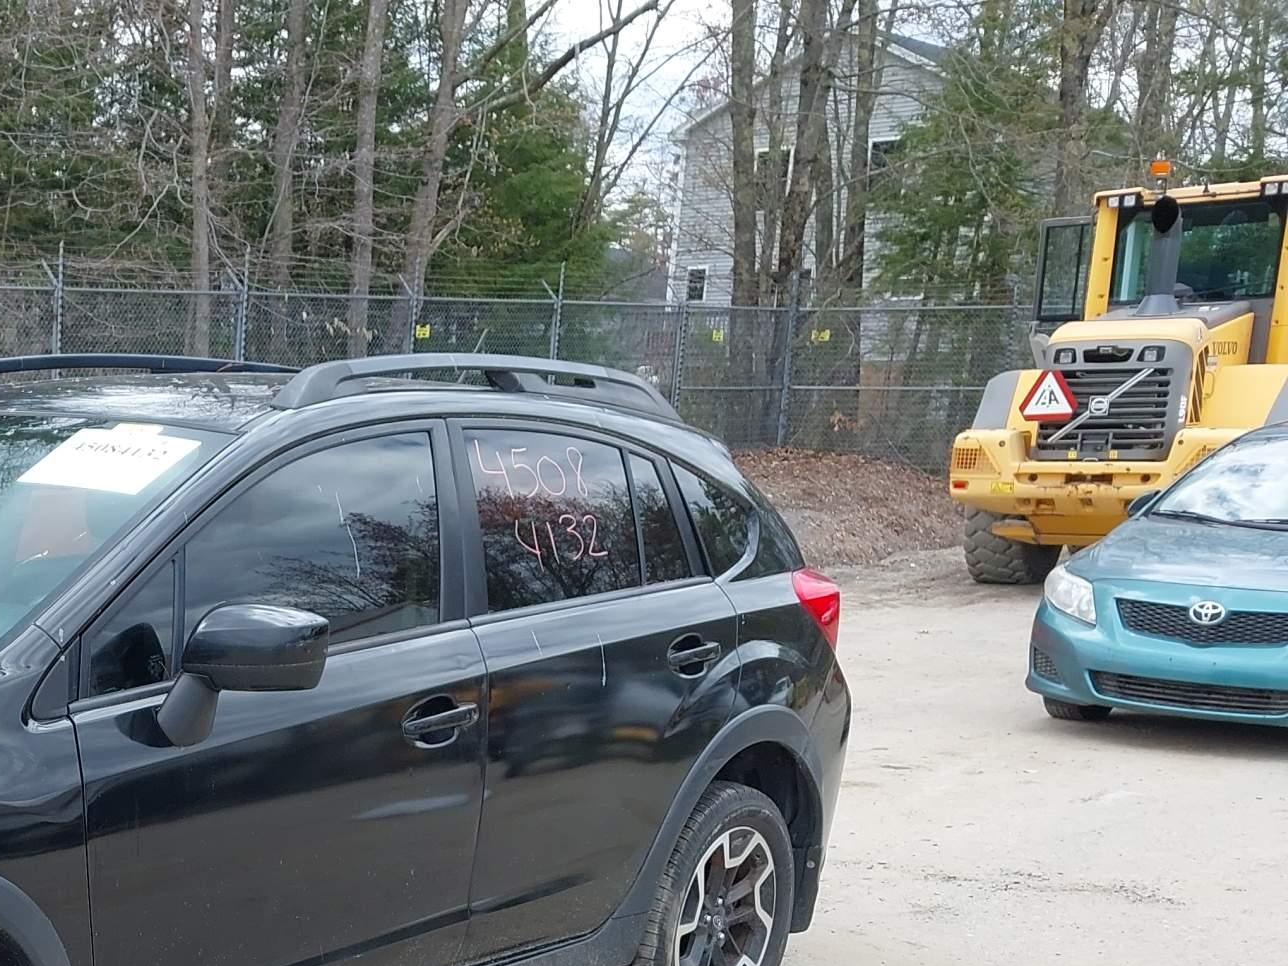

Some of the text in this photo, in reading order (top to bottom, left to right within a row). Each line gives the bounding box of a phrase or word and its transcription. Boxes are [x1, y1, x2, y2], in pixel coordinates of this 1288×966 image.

[1212, 341, 1238, 355] VOLVO
[474, 439, 588, 499] 4508
[515, 514, 608, 572] 4132
